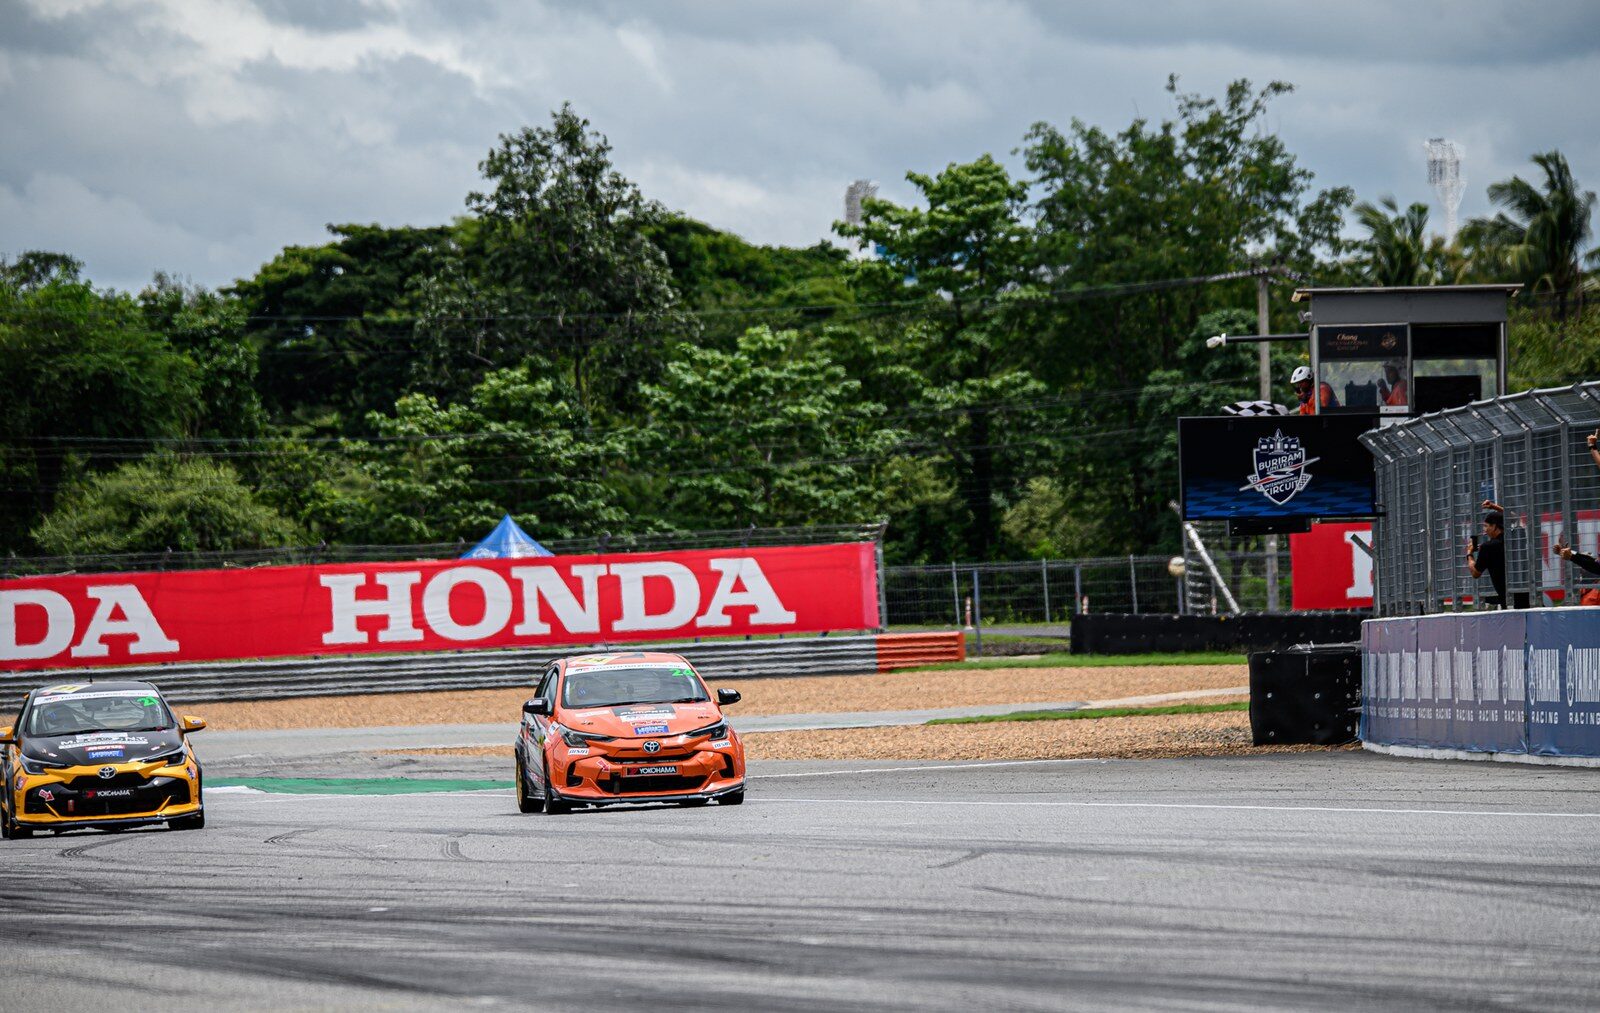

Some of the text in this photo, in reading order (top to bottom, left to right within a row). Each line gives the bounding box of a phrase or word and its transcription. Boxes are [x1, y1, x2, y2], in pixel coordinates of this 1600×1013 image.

[1336, 333, 1358, 341] Chang
[1258, 451, 1302, 471] BURIRAM
[1266, 461, 1294, 473] UNITED
[1264, 480, 1300, 496] CIRCUIT
[319, 557, 797, 646] HONDA
[1531, 710, 1559, 725] RACING
[639, 766, 676, 774] YOKOHAMA
[96, 789, 131, 797] YOKOHAMA
